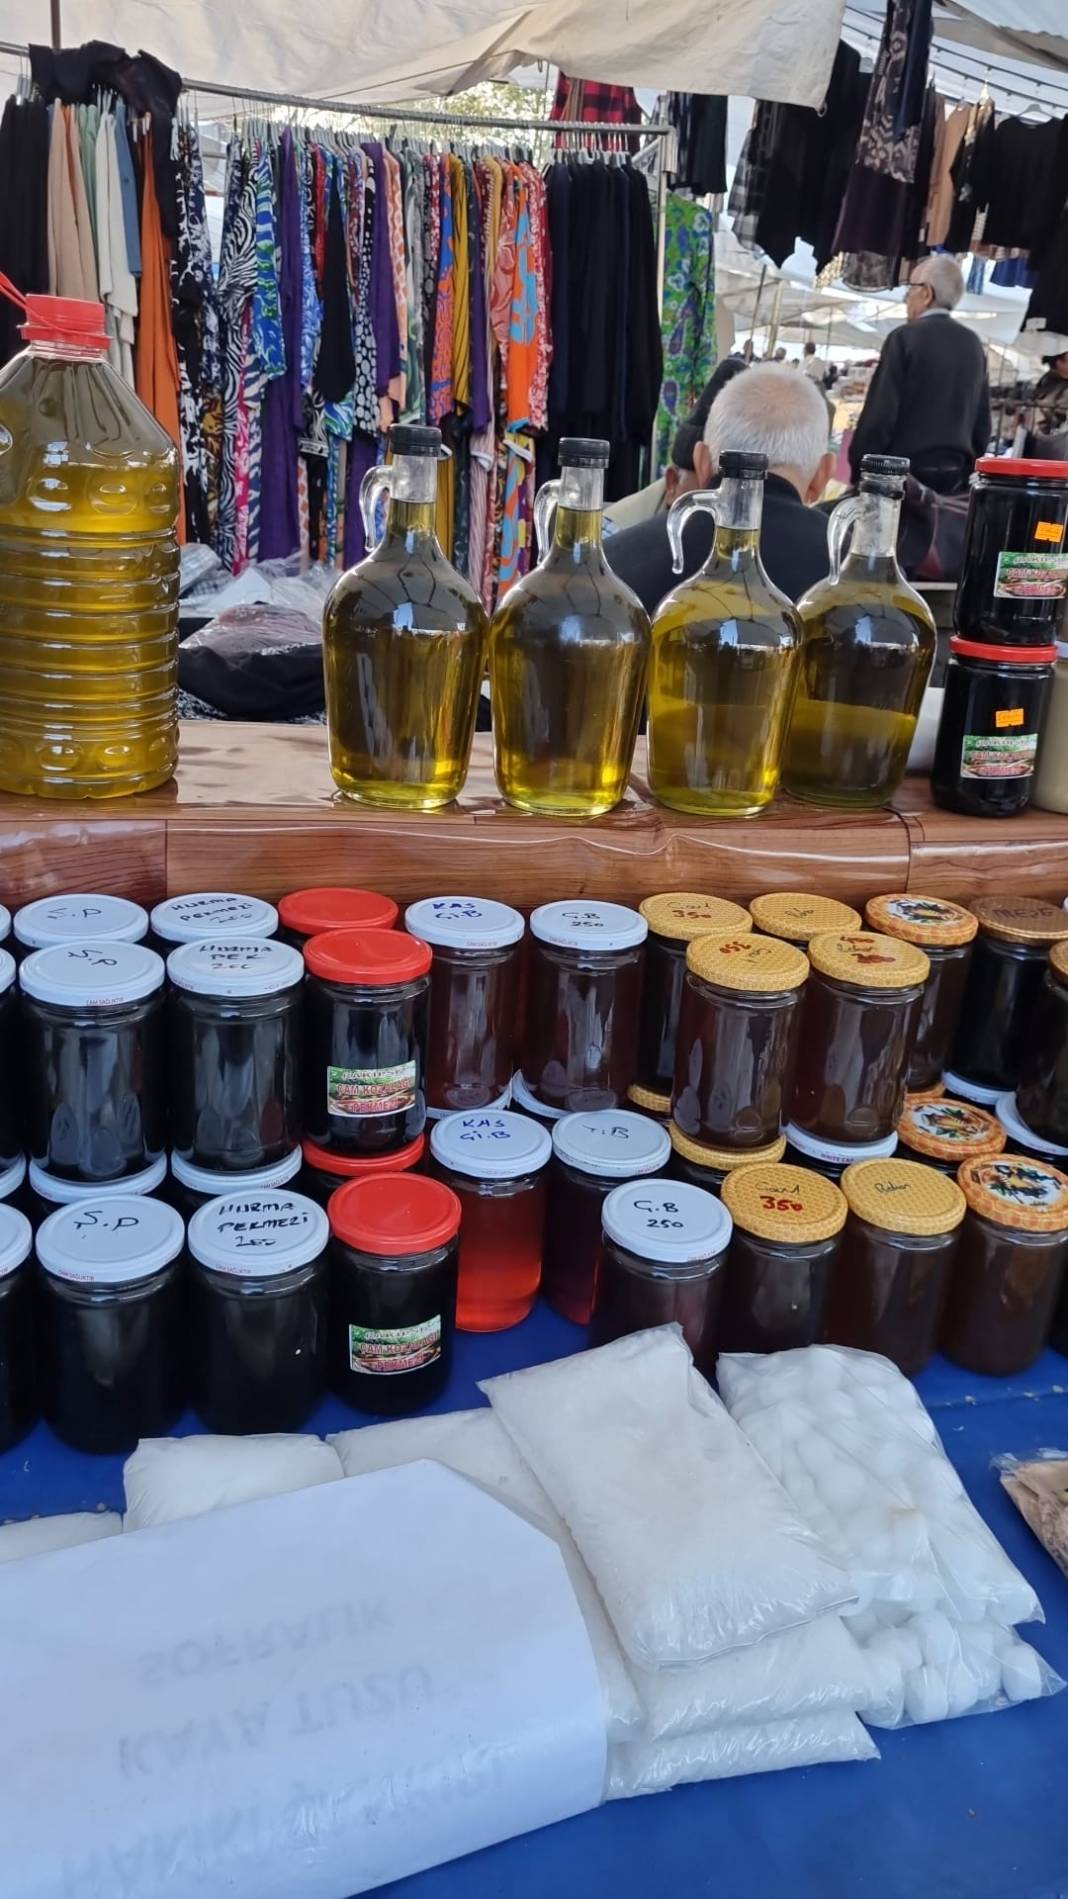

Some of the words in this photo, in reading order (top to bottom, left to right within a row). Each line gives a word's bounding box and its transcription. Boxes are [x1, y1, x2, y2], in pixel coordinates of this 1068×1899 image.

[671, 909, 713, 919] 350
[760, 1195, 804, 1212] 350
[646, 1218, 685, 1229] 250
